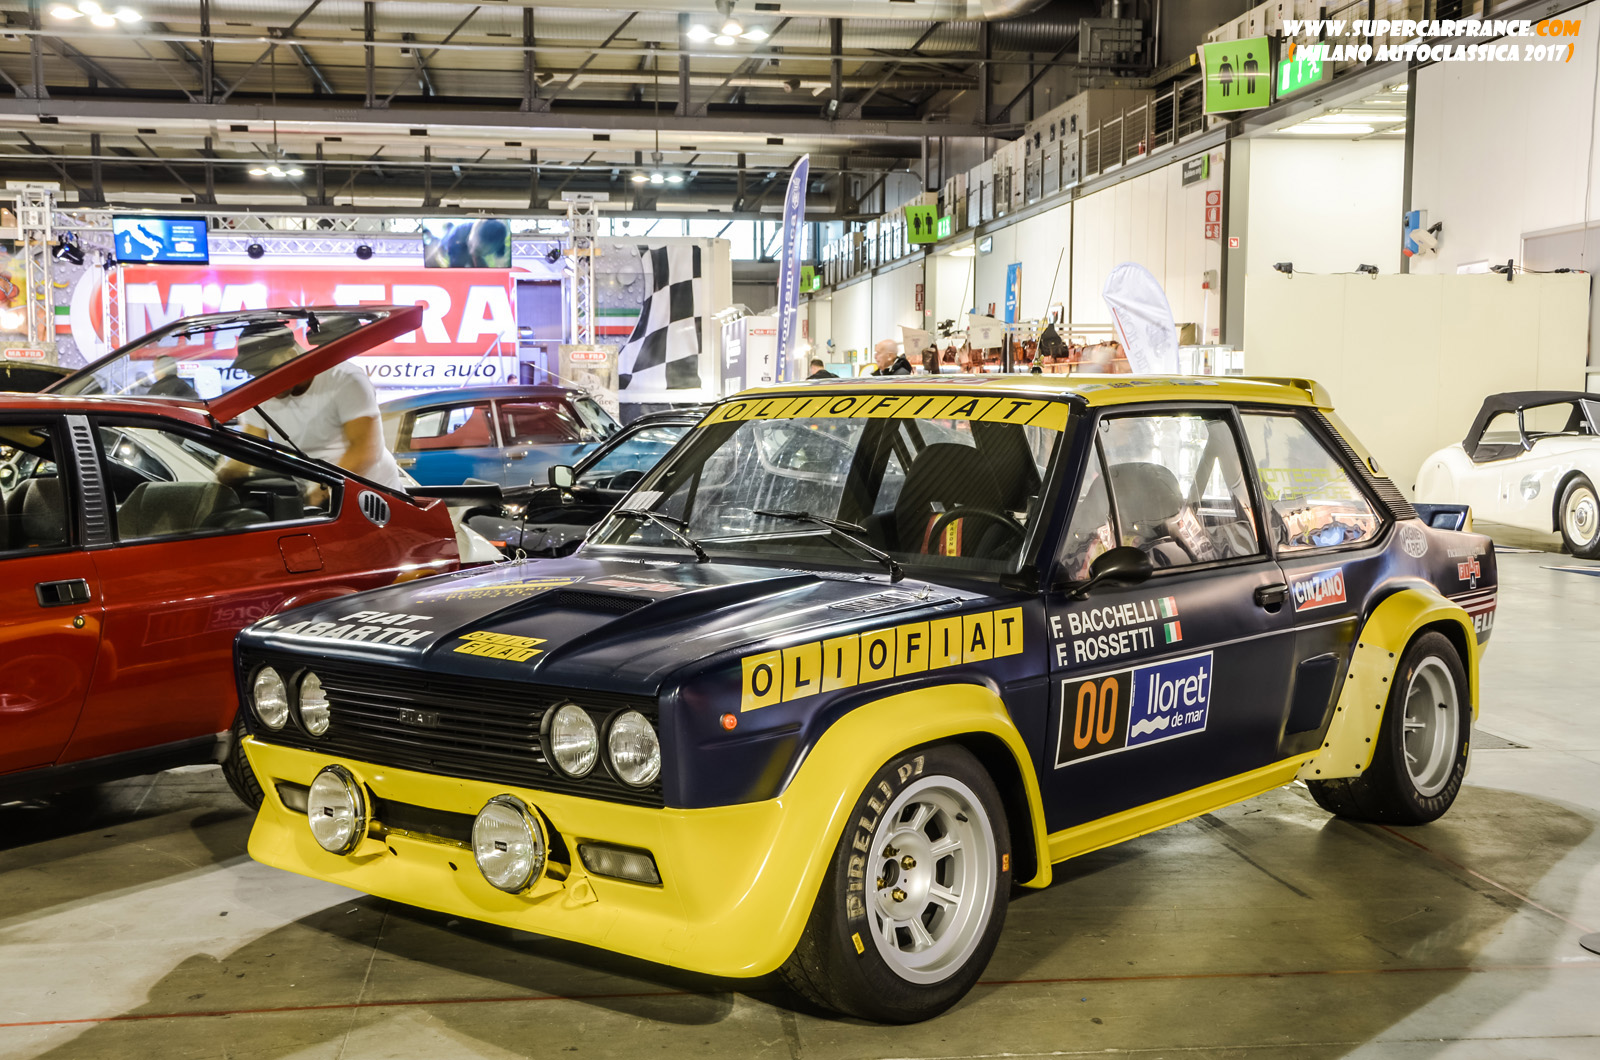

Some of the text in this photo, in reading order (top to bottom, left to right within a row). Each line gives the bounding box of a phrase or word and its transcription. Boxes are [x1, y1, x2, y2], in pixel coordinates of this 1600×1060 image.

[365, 362, 496, 377] vostra auto
[1295, 575, 1342, 603] CINZANO
[338, 611, 434, 626] FIAT
[1050, 600, 1158, 638] F. BACCHELLI
[464, 643, 533, 658] FIAT
[469, 633, 537, 645] OLIO
[1056, 627, 1154, 666] F. ROSSETTI
[1147, 667, 1207, 714] lloret
[401, 711, 432, 723] FIAT
[1074, 677, 1119, 750] 00
[1171, 708, 1203, 727] de mar
[846, 780, 893, 919] PIRELLI
